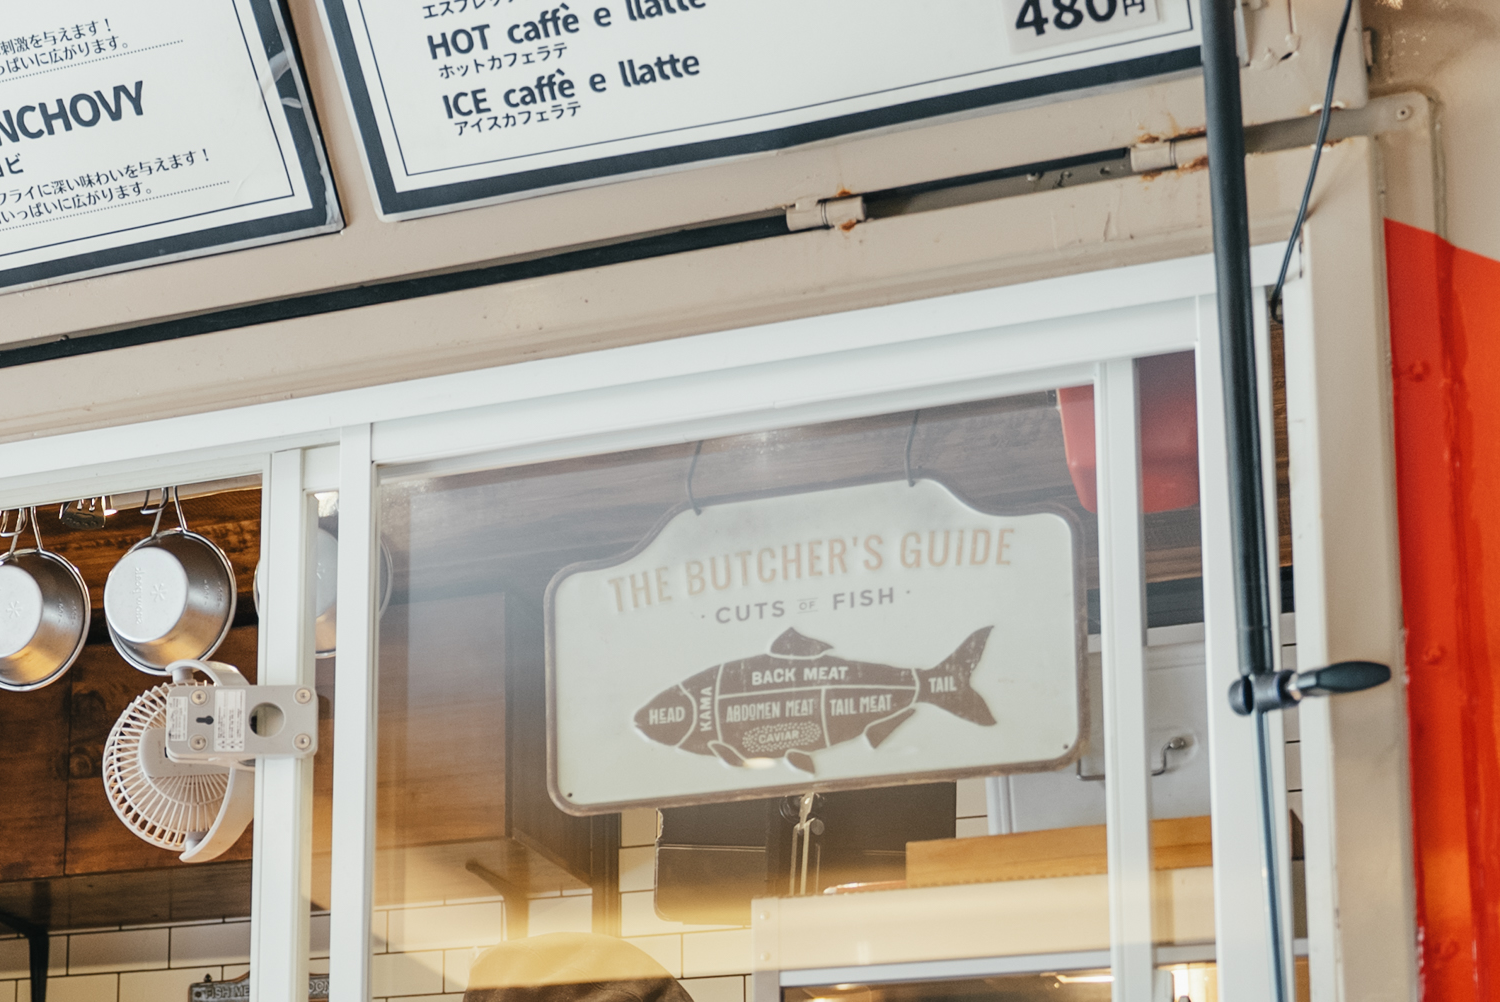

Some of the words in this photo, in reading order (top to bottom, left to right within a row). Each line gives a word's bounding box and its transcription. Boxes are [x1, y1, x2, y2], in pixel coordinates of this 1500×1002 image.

[427, 24, 491, 60] HOT
[507, 2, 580, 44] caffè
[593, 6, 612, 27] e
[438, 42, 568, 80] ホットカフェラテ
[442, 88, 492, 119] ICE
[503, 68, 575, 108] caffè
[589, 72, 607, 93] e
[618, 53, 700, 88] llatte
[454, 101, 581, 137] アイスカフェラテ
[607, 566, 672, 613] THE
[685, 533, 884, 596] BUTCHER'S
[900, 528, 1015, 569] GUIDE
[715, 601, 786, 624] CUTS
[798, 601, 816, 611] OF
[833, 587, 894, 611] FISH
[751, 668, 796, 687] BACK
[803, 666, 849, 682] MEAT
[928, 676, 958, 694] TAIL
[649, 706, 686, 726] HEAD
[699, 686, 713, 732] KAMA
[725, 700, 781, 724] ABDOMEN
[785, 698, 815, 718] MEAT
[829, 697, 857, 717] TAIL
[859, 694, 893, 714] MEAT
[757, 729, 801, 745] CAVIAR
